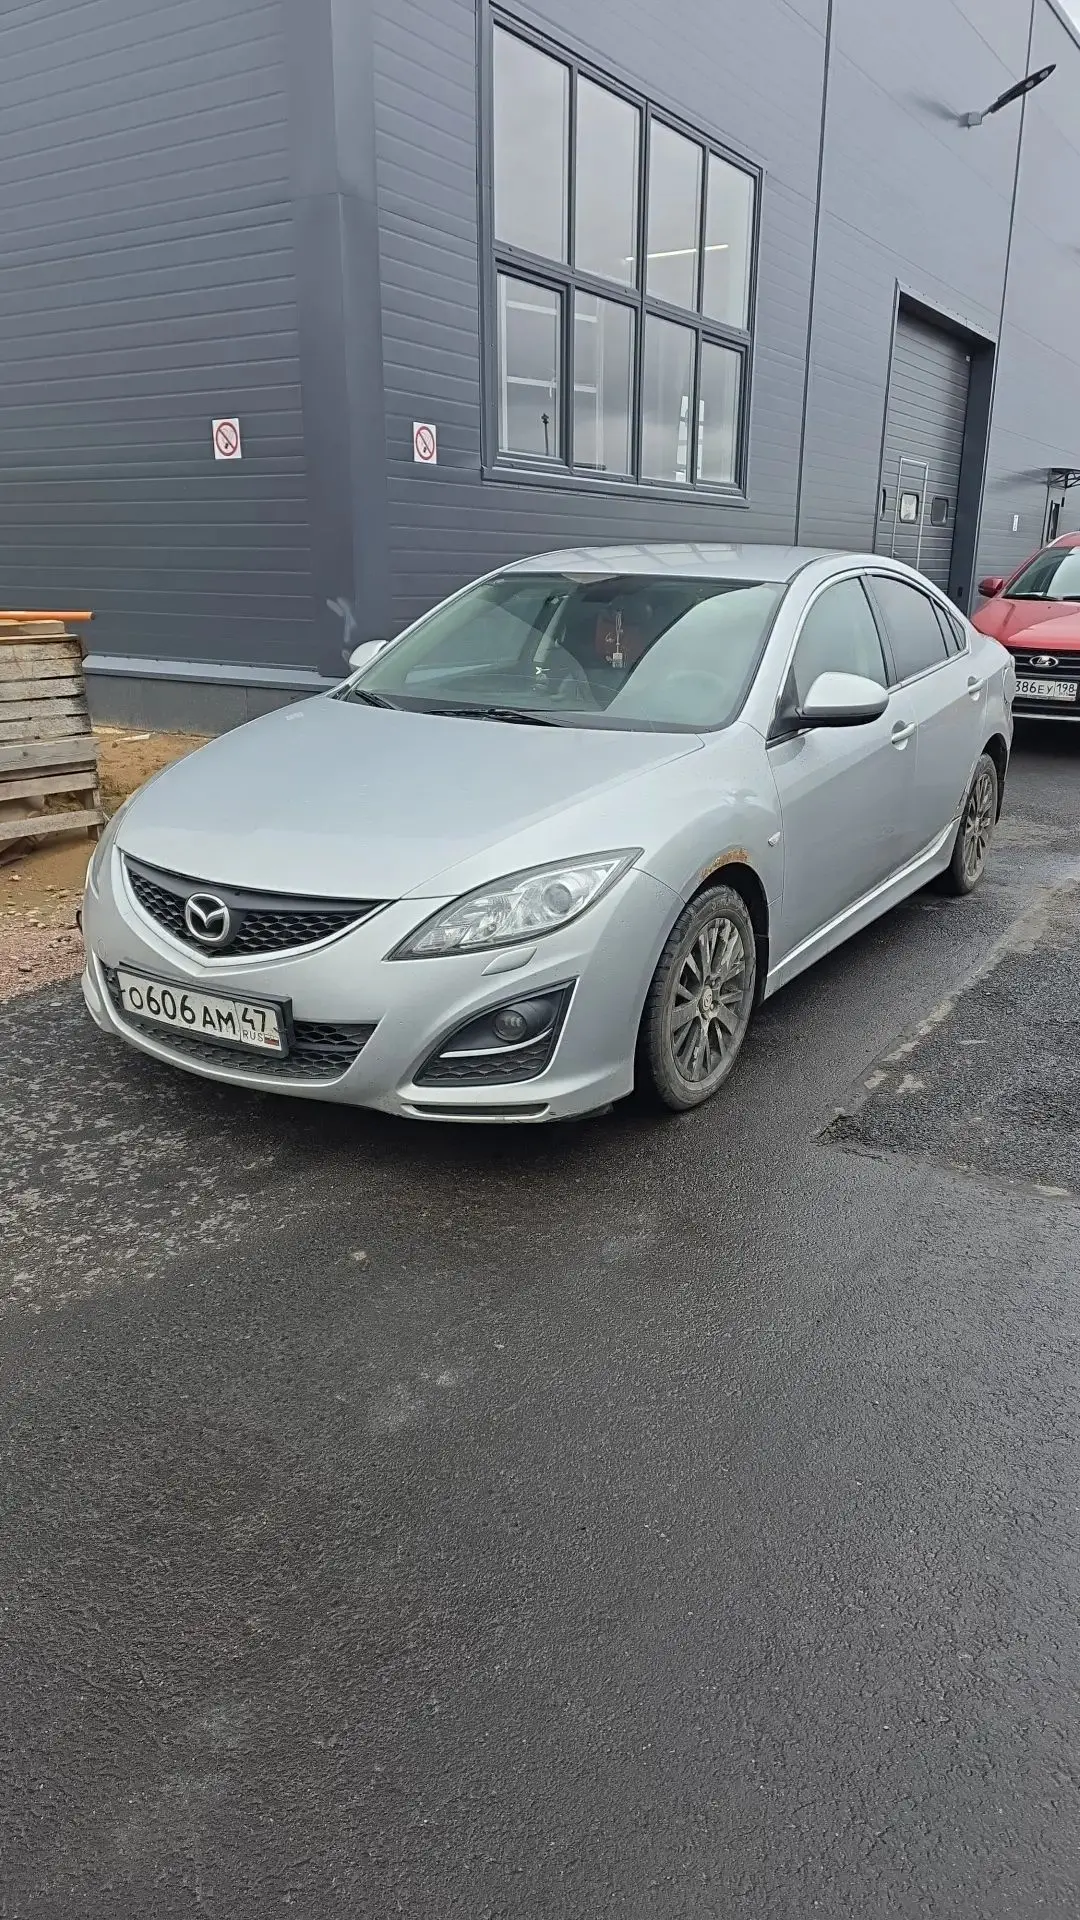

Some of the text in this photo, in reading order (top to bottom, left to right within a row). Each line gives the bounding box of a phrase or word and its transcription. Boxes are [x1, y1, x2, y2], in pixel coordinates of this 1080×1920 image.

[1057, 684, 1075, 692] 198
[242, 1008, 266, 1032] 47
[243, 1030, 264, 1042] RUS
